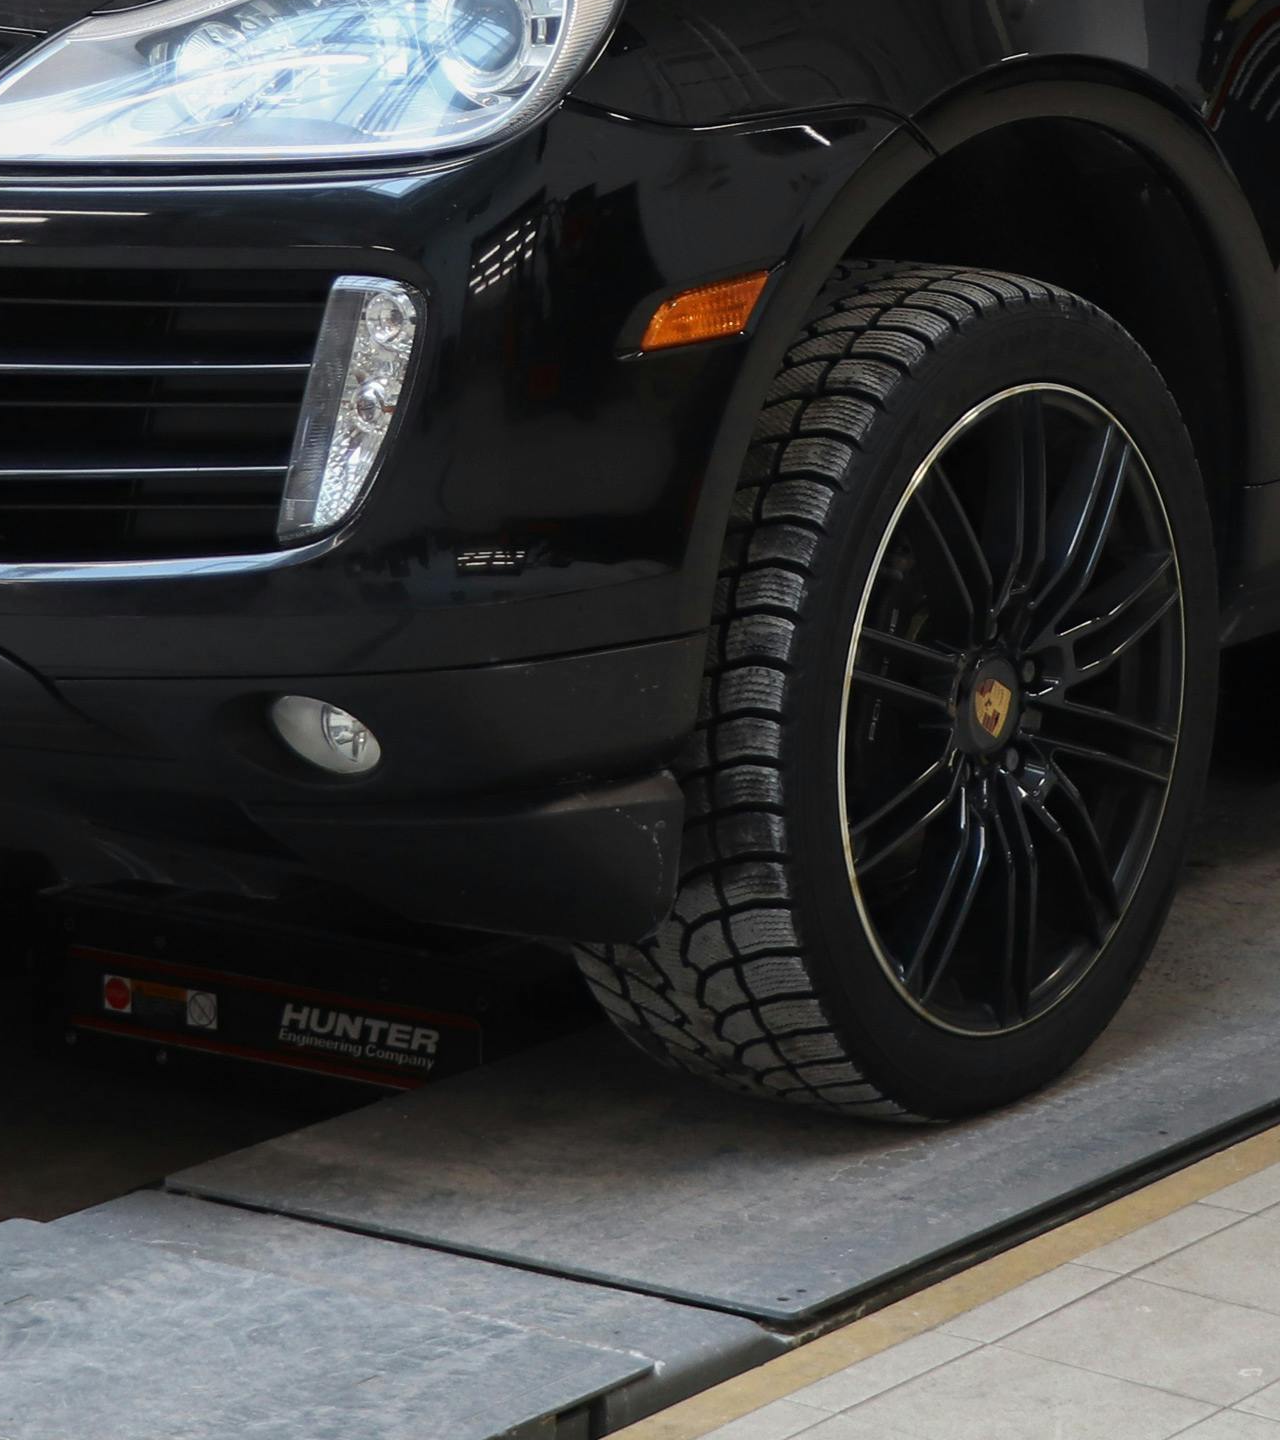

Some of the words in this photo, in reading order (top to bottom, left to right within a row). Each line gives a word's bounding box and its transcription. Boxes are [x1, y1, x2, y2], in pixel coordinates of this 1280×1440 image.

[277, 1027, 363, 1058] Engineering
[365, 1043, 435, 1072] Company
[281, 1003, 440, 1054] HUNTER
